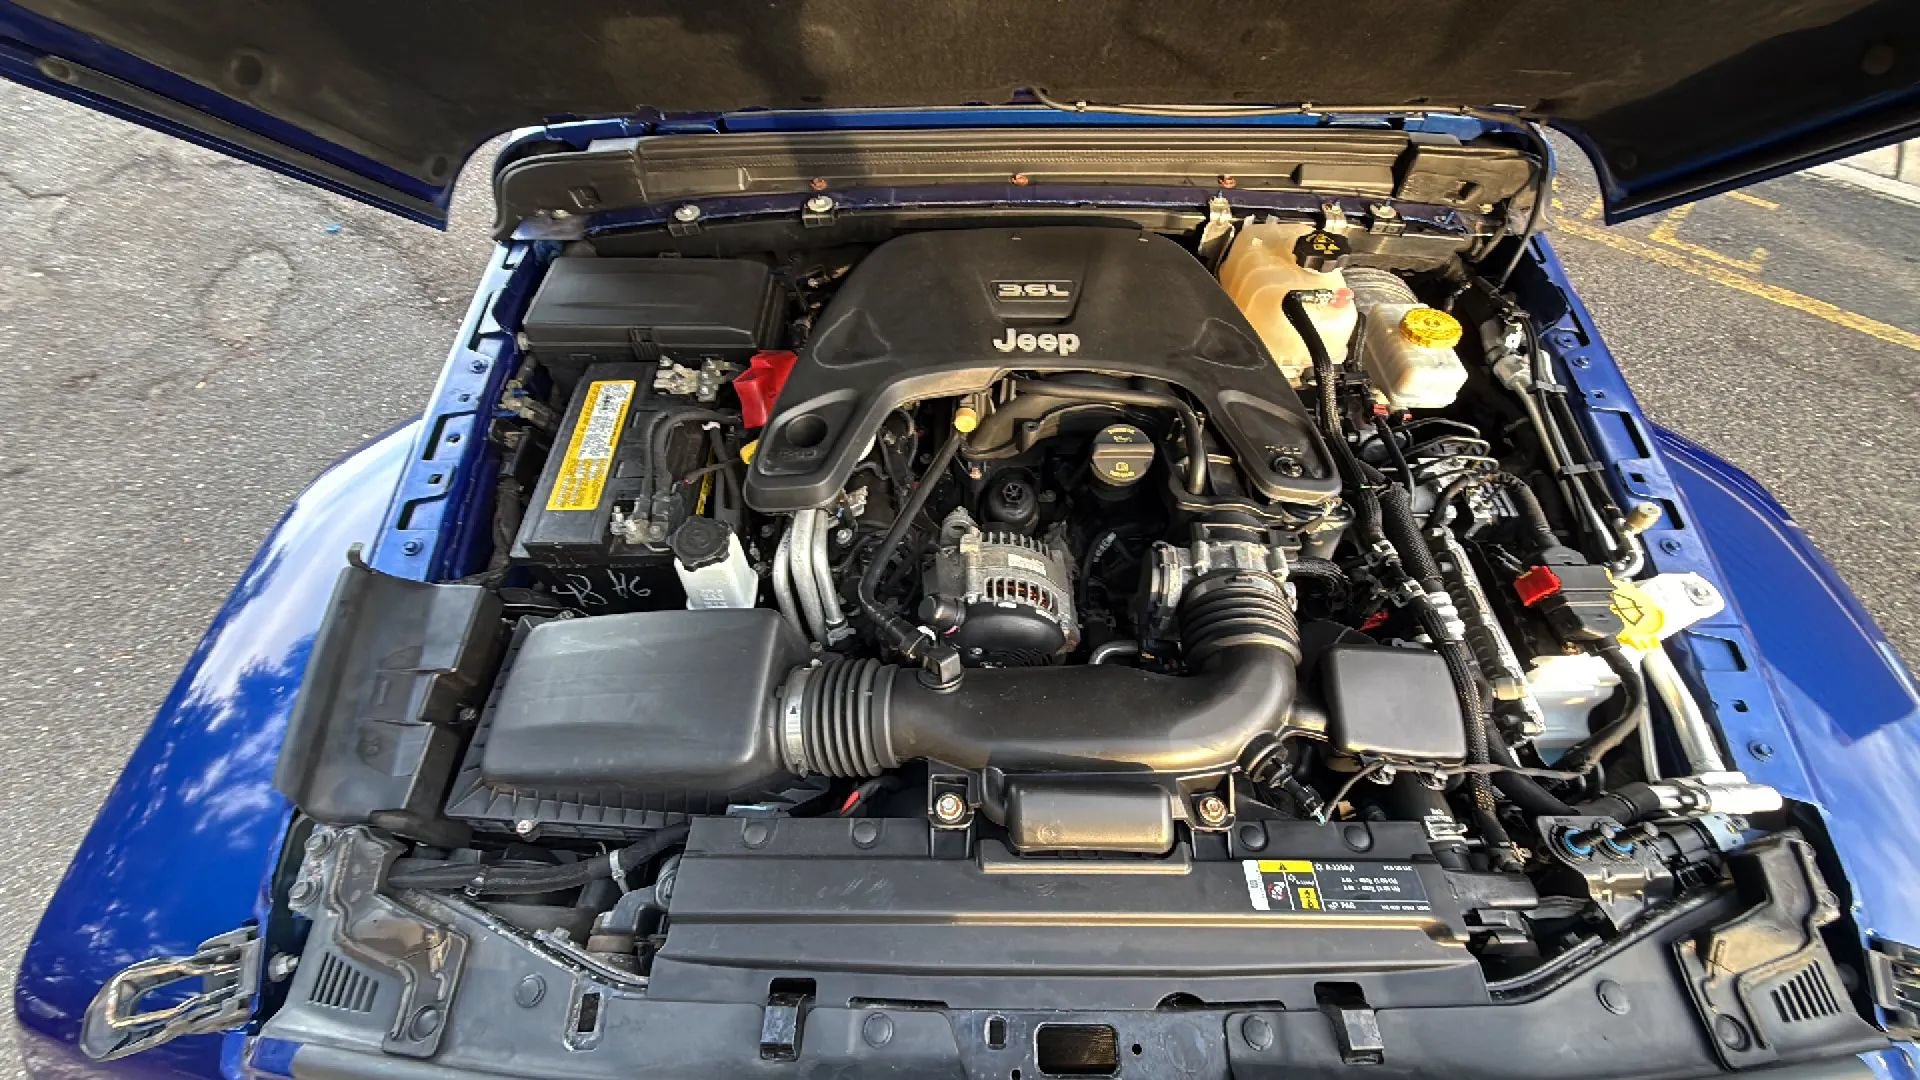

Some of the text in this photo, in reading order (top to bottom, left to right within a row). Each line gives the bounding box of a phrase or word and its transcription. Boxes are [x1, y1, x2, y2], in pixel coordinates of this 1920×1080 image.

[998, 283, 1070, 296] 3.6L
[993, 328, 1080, 356] Jeep
[607, 568, 651, 598] H6
